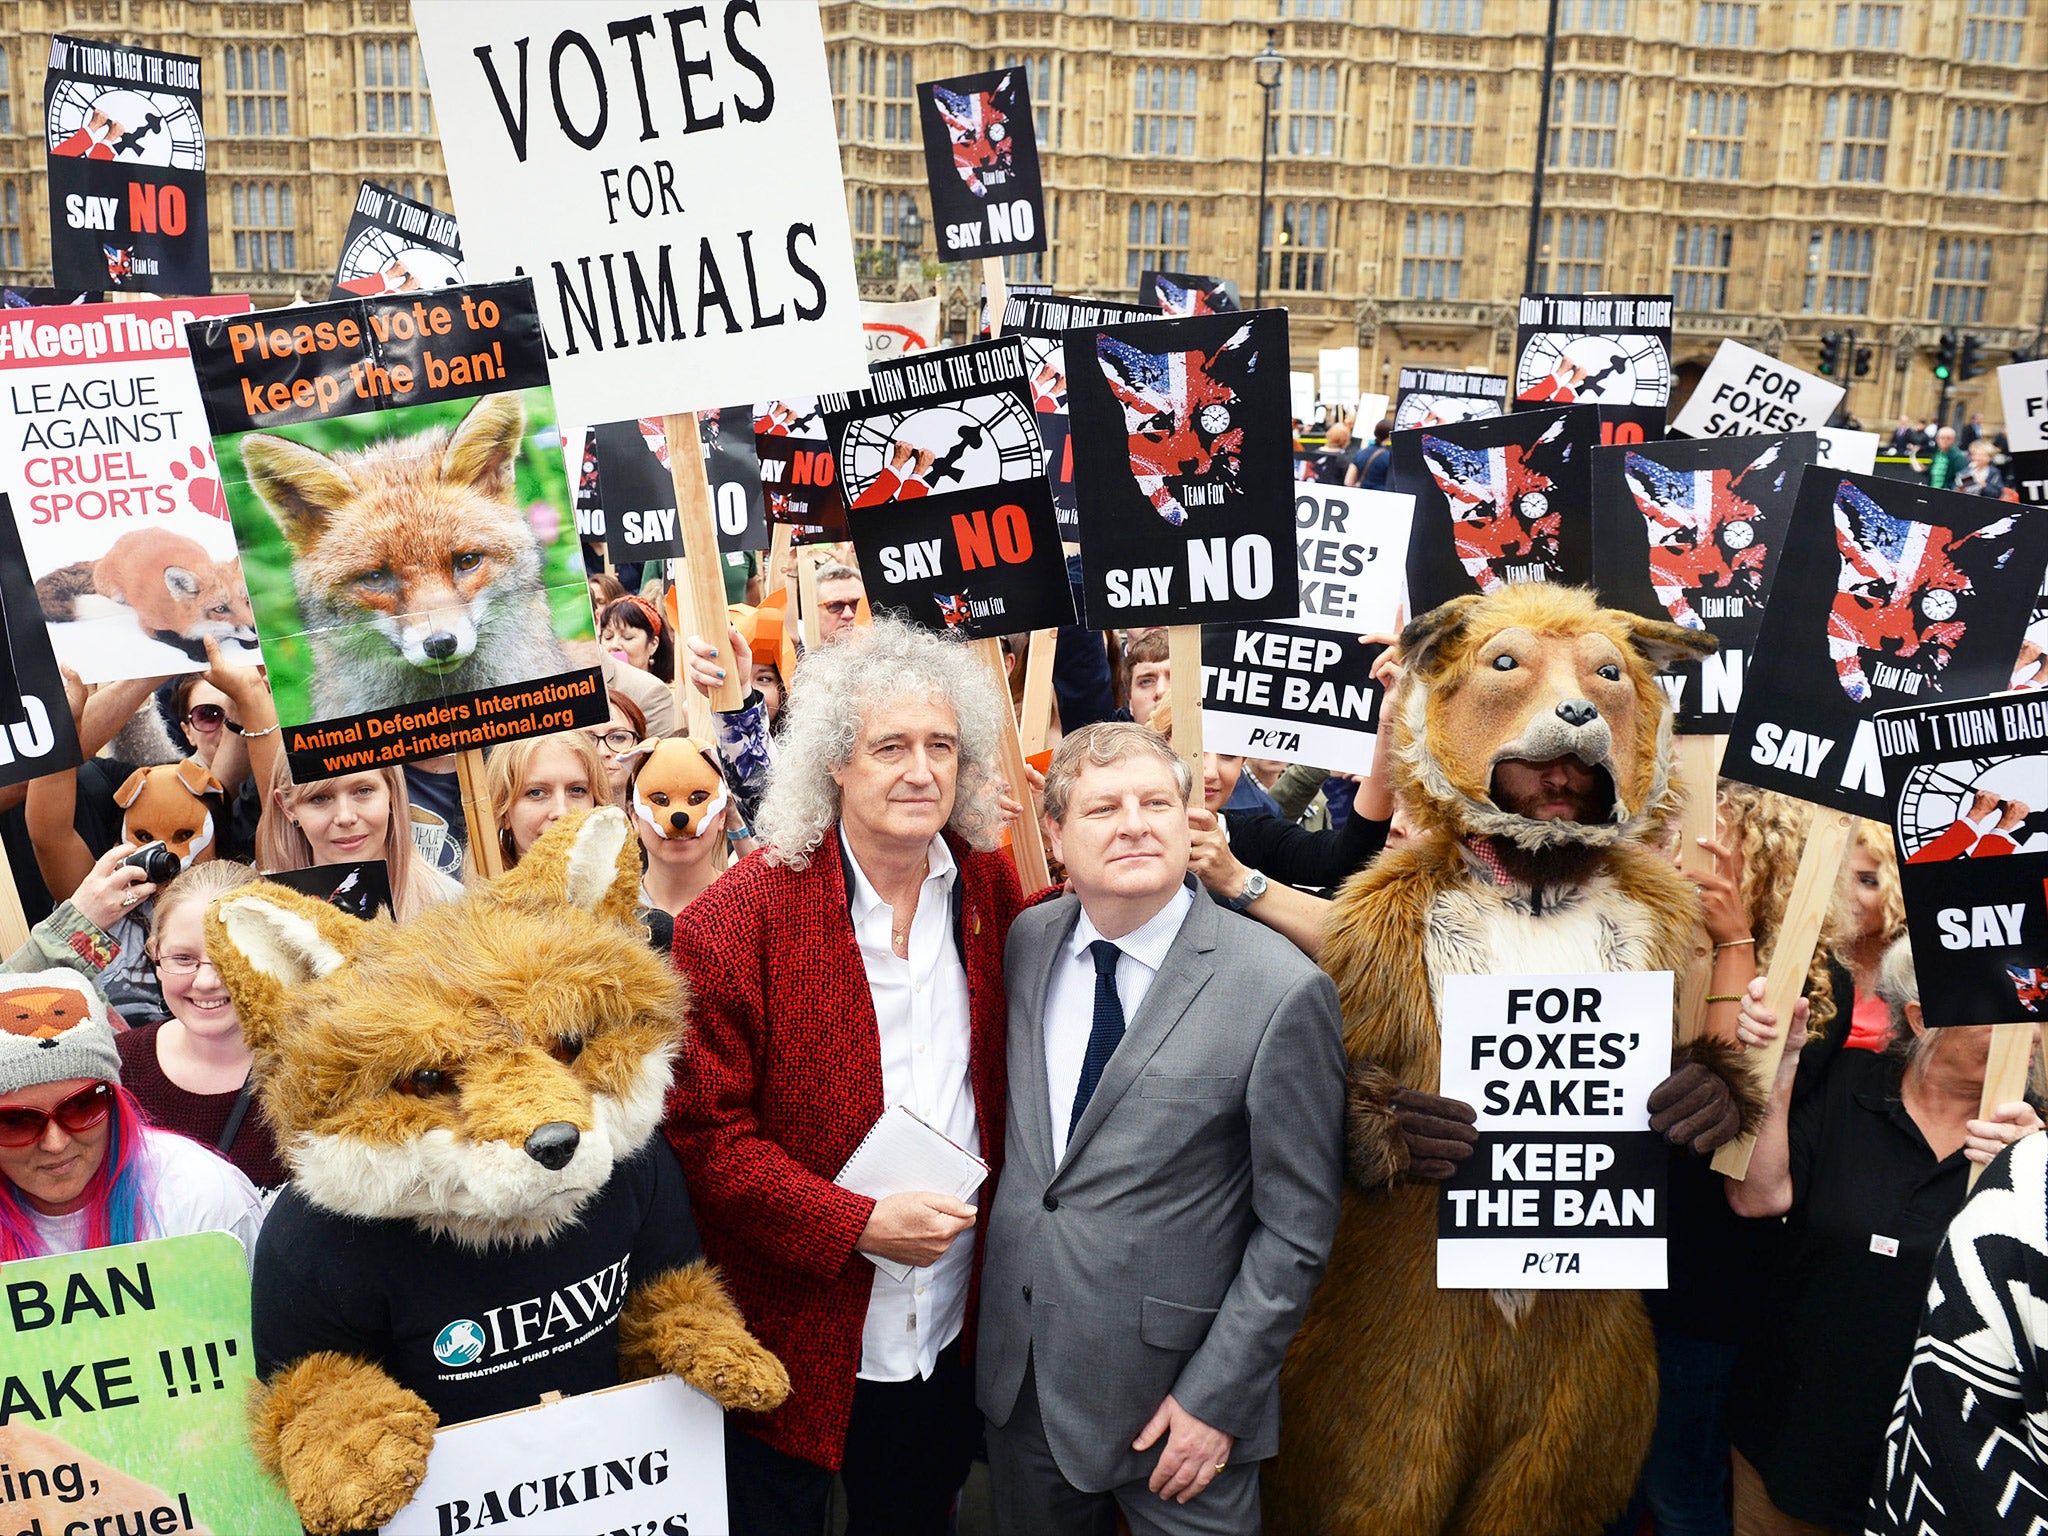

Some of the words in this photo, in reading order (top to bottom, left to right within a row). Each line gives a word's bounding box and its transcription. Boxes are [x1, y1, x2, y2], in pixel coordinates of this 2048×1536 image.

[80, 45, 112, 77] TURN
[113, 50, 143, 82] BACK
[144, 55, 164, 85] THE
[165, 59, 200, 90] CLOCK
[473, 0, 775, 162] VOTES
[65, 193, 119, 231] SAY
[127, 181, 188, 237] NO
[601, 160, 685, 224] FOR
[396, 203, 430, 237] TURN
[427, 214, 459, 249] BACK
[945, 221, 982, 250] SAY
[986, 199, 1035, 245] NO
[514, 222, 827, 359] NIMALS
[0, 310, 237, 360] #KeepTheB
[228, 317, 362, 364] Please
[368, 301, 452, 343] vote
[460, 295, 501, 331] to
[1041, 302, 1070, 330] TURN
[1071, 307, 1100, 329] BACK
[1556, 300, 1582, 326] TURN
[1582, 300, 1613, 327] BACK
[1614, 300, 1636, 327] THE
[1636, 300, 1672, 328] CLOCK
[11, 377, 159, 415] LEAGUE
[240, 372, 340, 416] keep
[351, 359, 415, 399] the
[422, 341, 507, 389] ban!
[869, 367, 907, 406] TURN
[905, 359, 948, 399] BACK
[945, 354, 977, 390] THE
[976, 344, 1025, 385] CLOCK
[1745, 364, 1802, 404] FOR
[21, 411, 183, 451] AGAINST
[1711, 383, 1808, 433] FOXES'
[24, 451, 147, 488] CRUEL
[757, 459, 787, 483] AY
[791, 450, 835, 487] NO
[30, 484, 177, 525] SPORTS
[576, 508, 606, 536] NO
[622, 508, 677, 546] SAY
[1296, 496, 1350, 534] OR
[879, 538, 943, 584] SAY
[951, 504, 1034, 572] NO
[1105, 566, 1174, 609] SAY
[1186, 533, 1274, 604] NO
[1299, 580, 1358, 619] KE:
[1233, 629, 1343, 674] KEEP
[293, 722, 363, 752] Animal
[367, 701, 471, 739] Defenders
[475, 674, 597, 717] International
[1201, 665, 1273, 708] THE
[1281, 676, 1374, 722] BAN
[322, 707, 575, 772] www.ad-international.org
[1750, 722, 1836, 779] SAY
[1944, 708, 1999, 749] TURN
[1936, 903, 2027, 951] SAY
[1507, 987, 1602, 1025] FOR
[1470, 1032, 1640, 1071] FOXES'
[1482, 1079, 1624, 1117] SAKE:
[1491, 1143, 1616, 1182] KEEP
[1447, 1188, 1540, 1228] THE
[1553, 1187, 1656, 1228] BAN
[6, 1262, 156, 1333] BAN
[483, 1261, 622, 1358] IFAW
[438, 1359, 520, 1382] INTERNATIONAL
[522, 1349, 550, 1365] FUND
[551, 1341, 573, 1355] FOR
[573, 1323, 604, 1347] ANIMAL
[0, 1356, 140, 1427] AKE
[0, 1462, 100, 1504] ing,
[435, 1448, 670, 1536] BACKING
[63, 1492, 194, 1536] cruel
